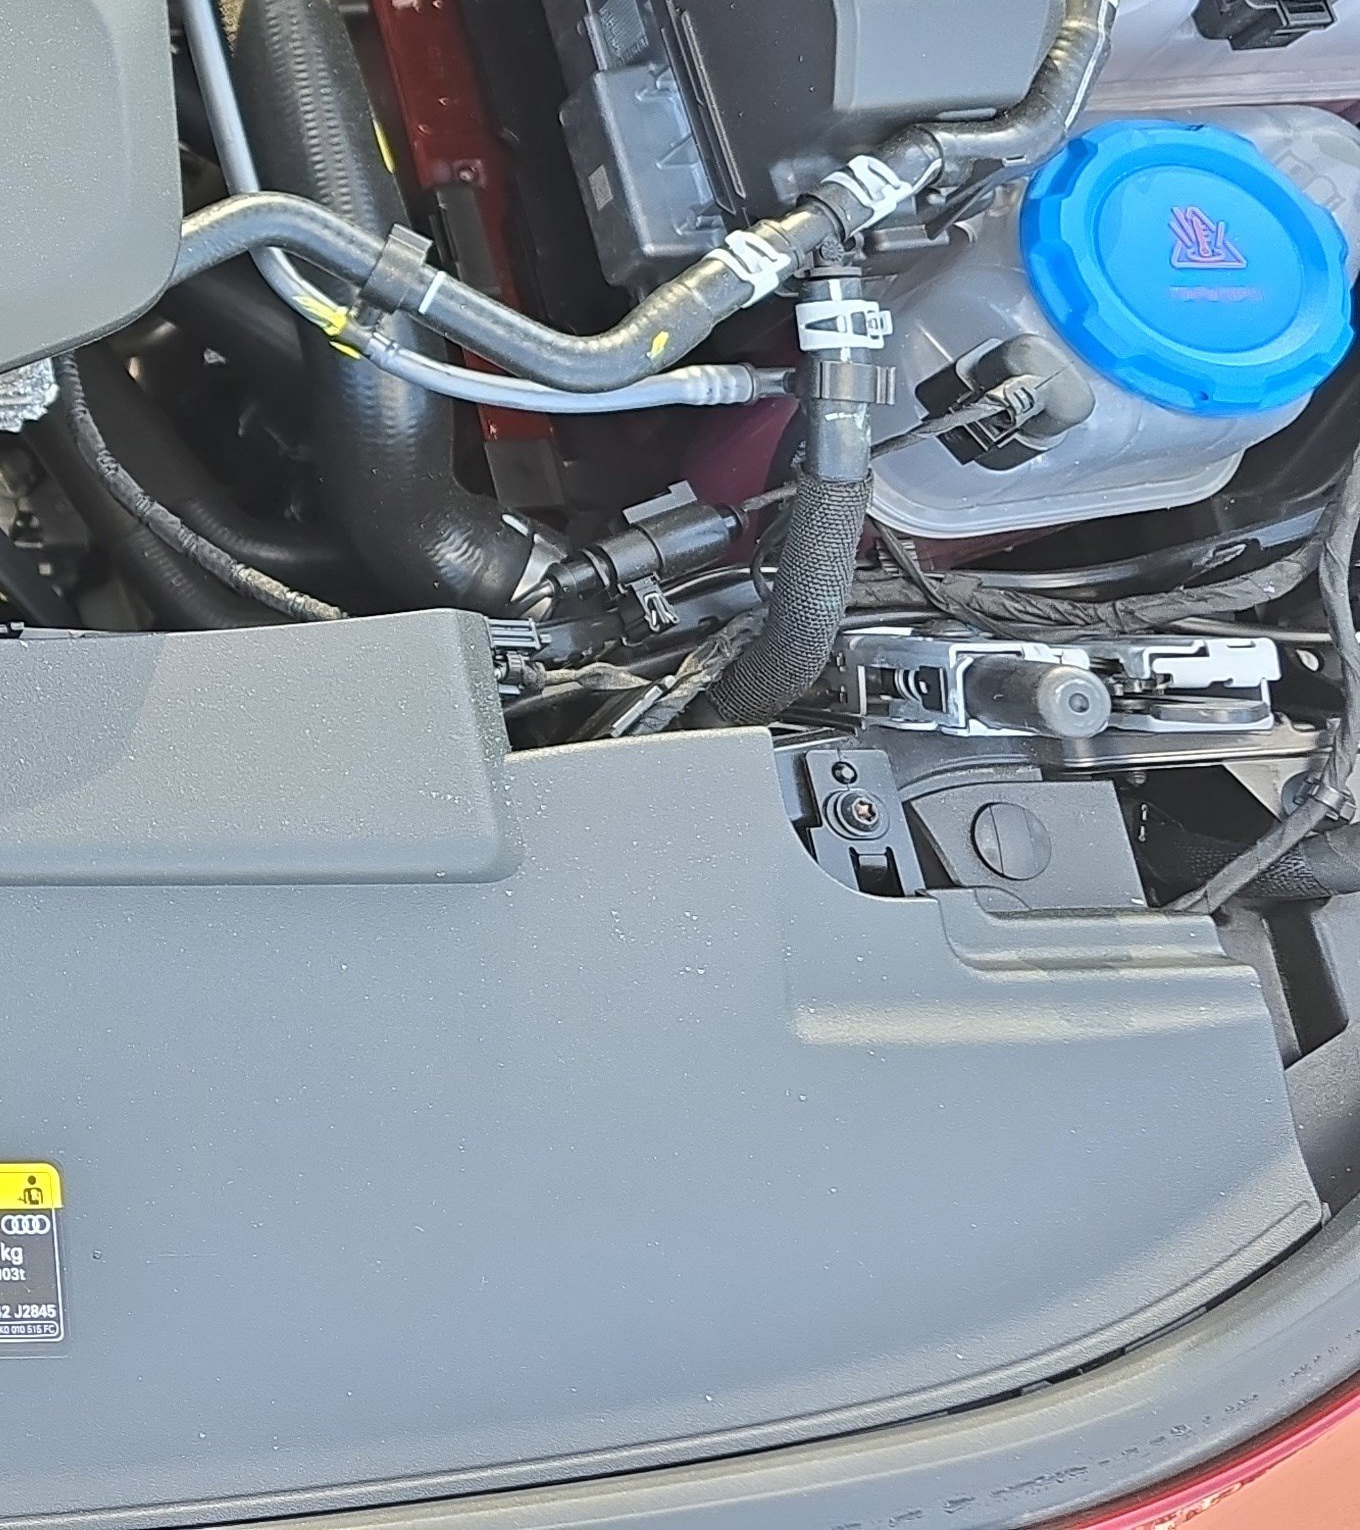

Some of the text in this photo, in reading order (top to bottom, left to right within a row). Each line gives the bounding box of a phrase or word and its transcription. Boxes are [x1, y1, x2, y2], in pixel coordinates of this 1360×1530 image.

[0, 1242, 23, 1265] kg
[14, 1304, 56, 1318] J2845
[11, 1325, 25, 1334] 010
[44, 1325, 54, 1333] FC
